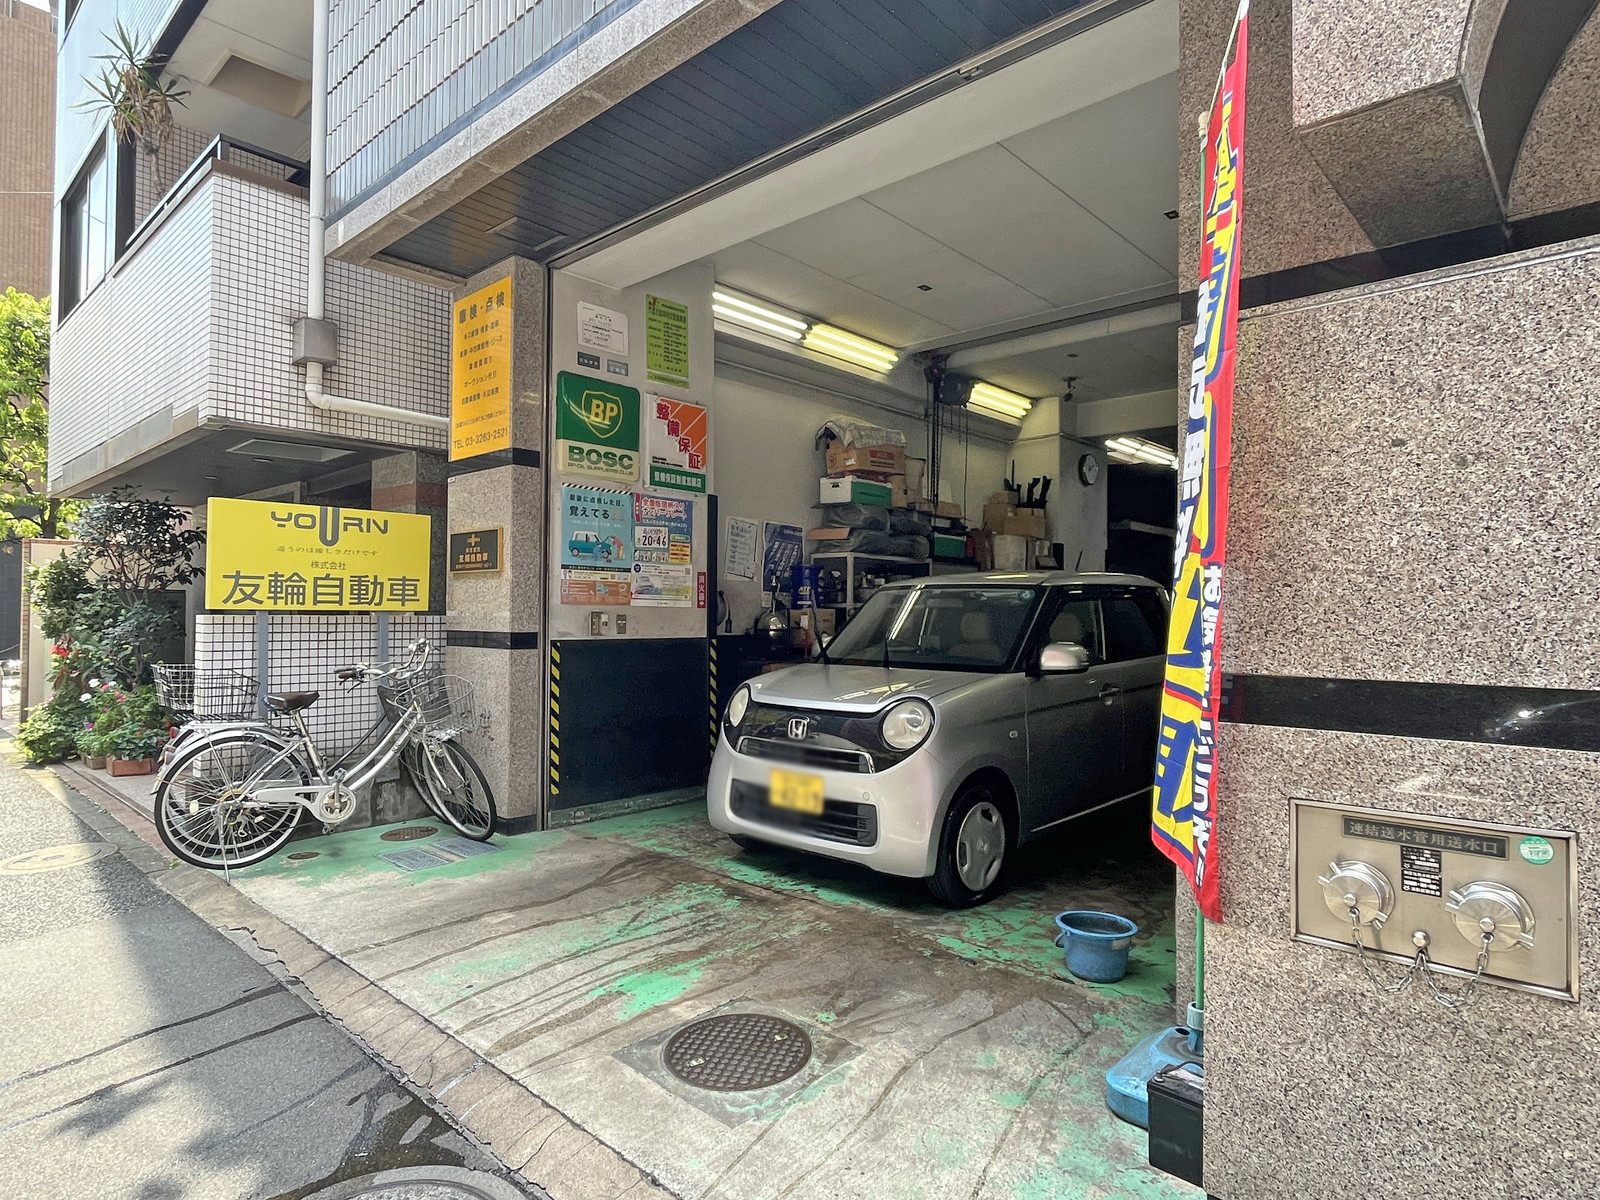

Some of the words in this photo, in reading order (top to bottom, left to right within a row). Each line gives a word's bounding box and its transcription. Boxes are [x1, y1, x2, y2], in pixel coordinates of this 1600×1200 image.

[459, 291, 505, 324] 車検・点検
[590, 399, 618, 423] BP
[454, 439, 463, 449] TEL
[465, 427, 508, 446] 03-3263-2521
[656, 402, 702, 470] 整備保証
[569, 445, 633, 470] BOSC
[570, 505, 609, 519] 覚えてる
[271, 506, 388, 547] YOURIN
[276, 546, 378, 556] 違うのは優しさだけです
[311, 561, 346, 570] 株式会社
[222, 570, 420, 606] 友輪自動車
[1349, 821, 1498, 854] 連結送水管用送水口
